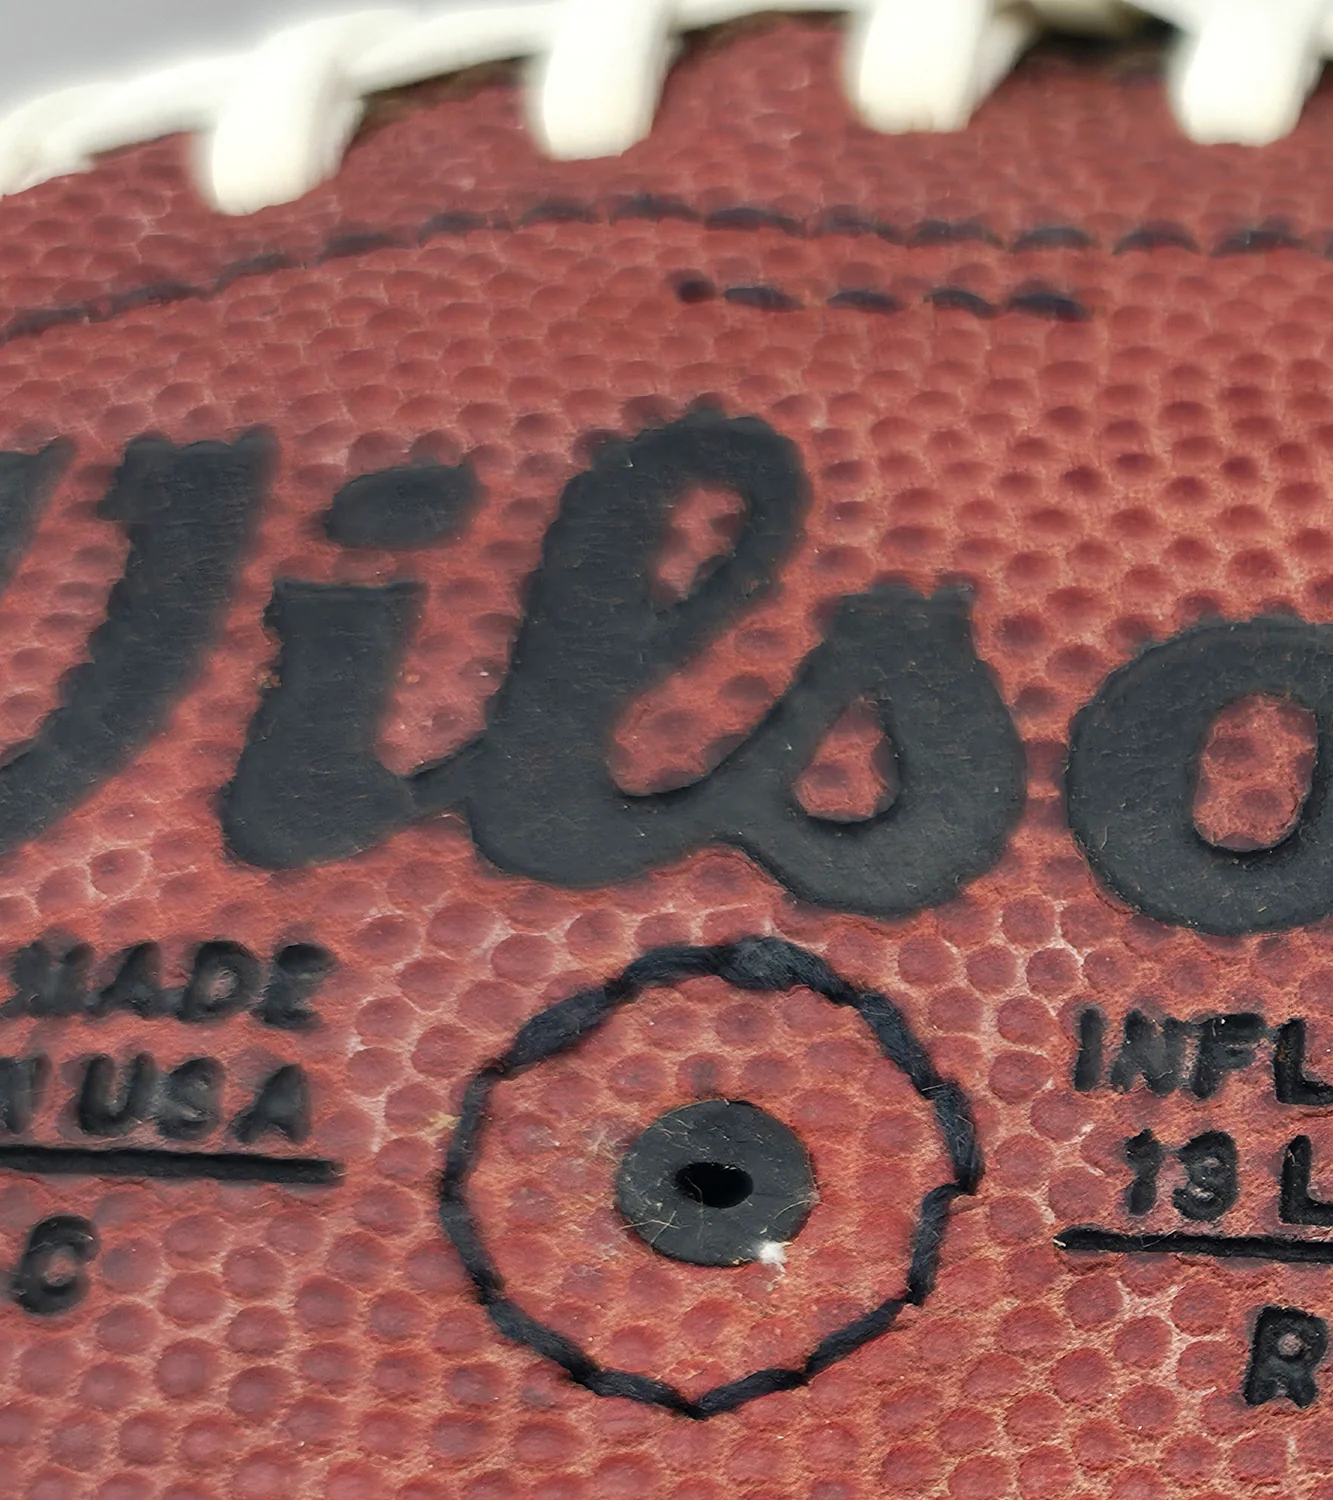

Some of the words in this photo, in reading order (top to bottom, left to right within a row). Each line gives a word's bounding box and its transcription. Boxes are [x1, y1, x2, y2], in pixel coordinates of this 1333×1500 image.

[2, 938, 338, 1033] MADE
[76, 1050, 313, 1145] USA
[1122, 1128, 1240, 1223] 13
